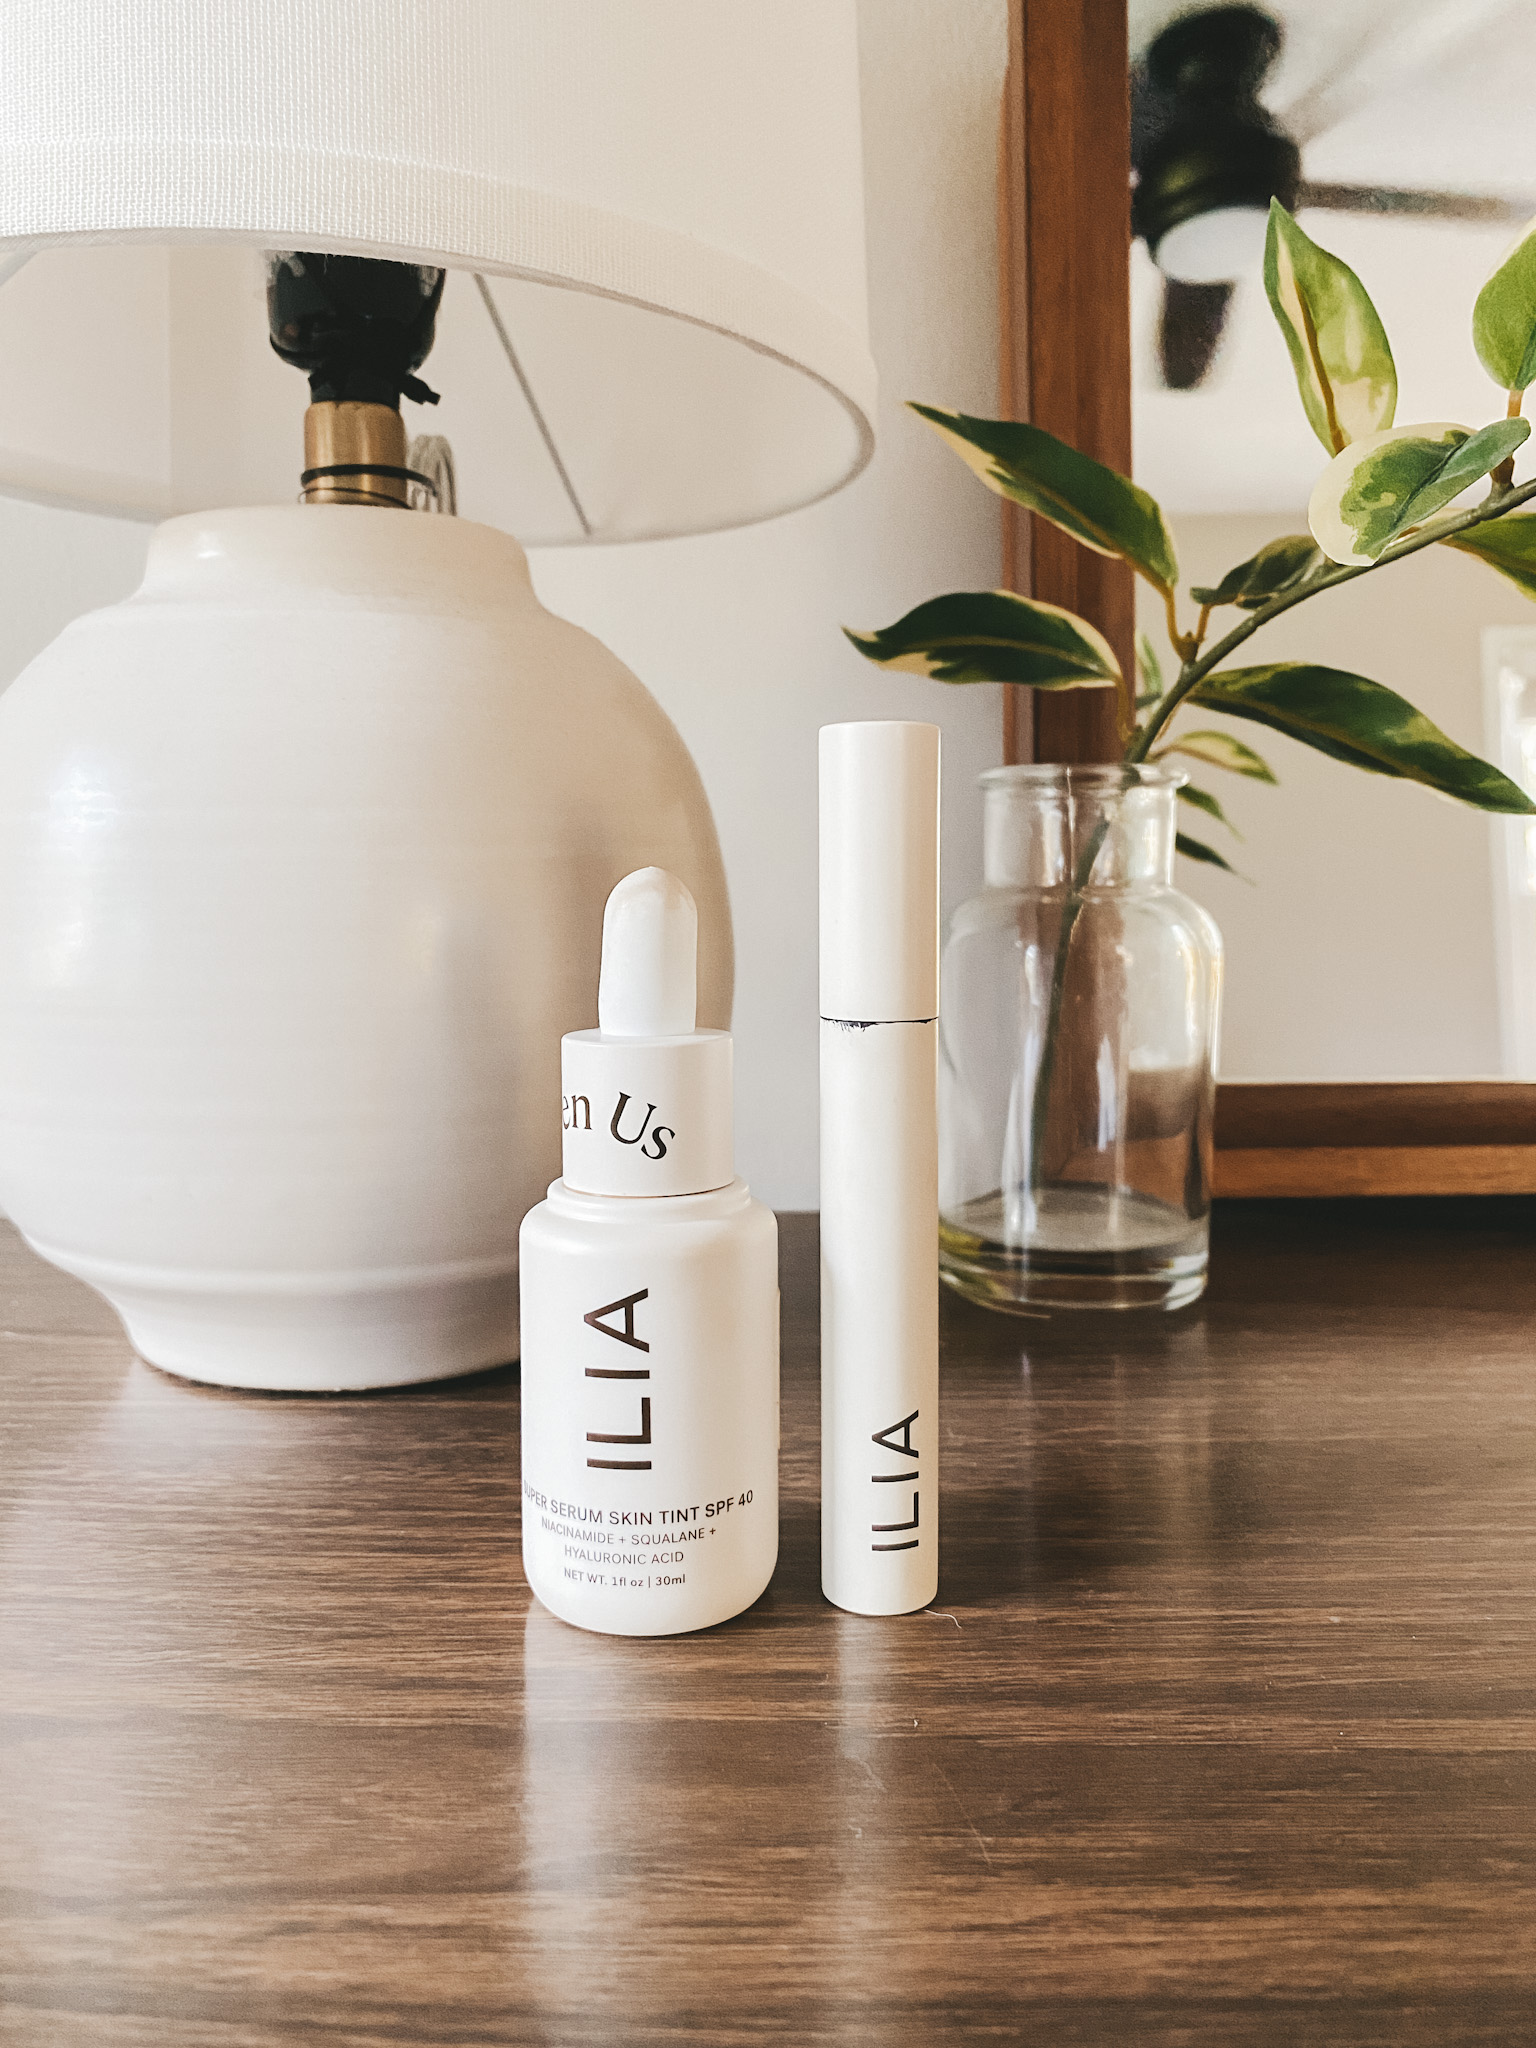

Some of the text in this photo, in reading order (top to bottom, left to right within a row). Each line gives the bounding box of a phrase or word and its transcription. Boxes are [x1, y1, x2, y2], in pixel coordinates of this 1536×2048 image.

[610, 1091, 676, 1160] Us
[584, 1288, 652, 1470] ILIA
[871, 1409, 919, 1551] ILIA
[550, 1500, 603, 1523] SERUM
[609, 1511, 653, 1525] SKIN
[658, 1506, 700, 1525] TINT
[705, 1497, 735, 1518] SPF
[738, 1489, 754, 1506] 40
[541, 1516, 615, 1544] NIACINAMIDE
[631, 1527, 706, 1545] SQUALANE
[564, 1544, 684, 1565] HYALURONIC ACID
[563, 1567, 584, 1582] NET
[587, 1574, 608, 1585] WT.
[612, 1576, 627, 1587] 1fl
[630, 1578, 644, 1587] oz
[655, 1574, 687, 1586] 30ml
